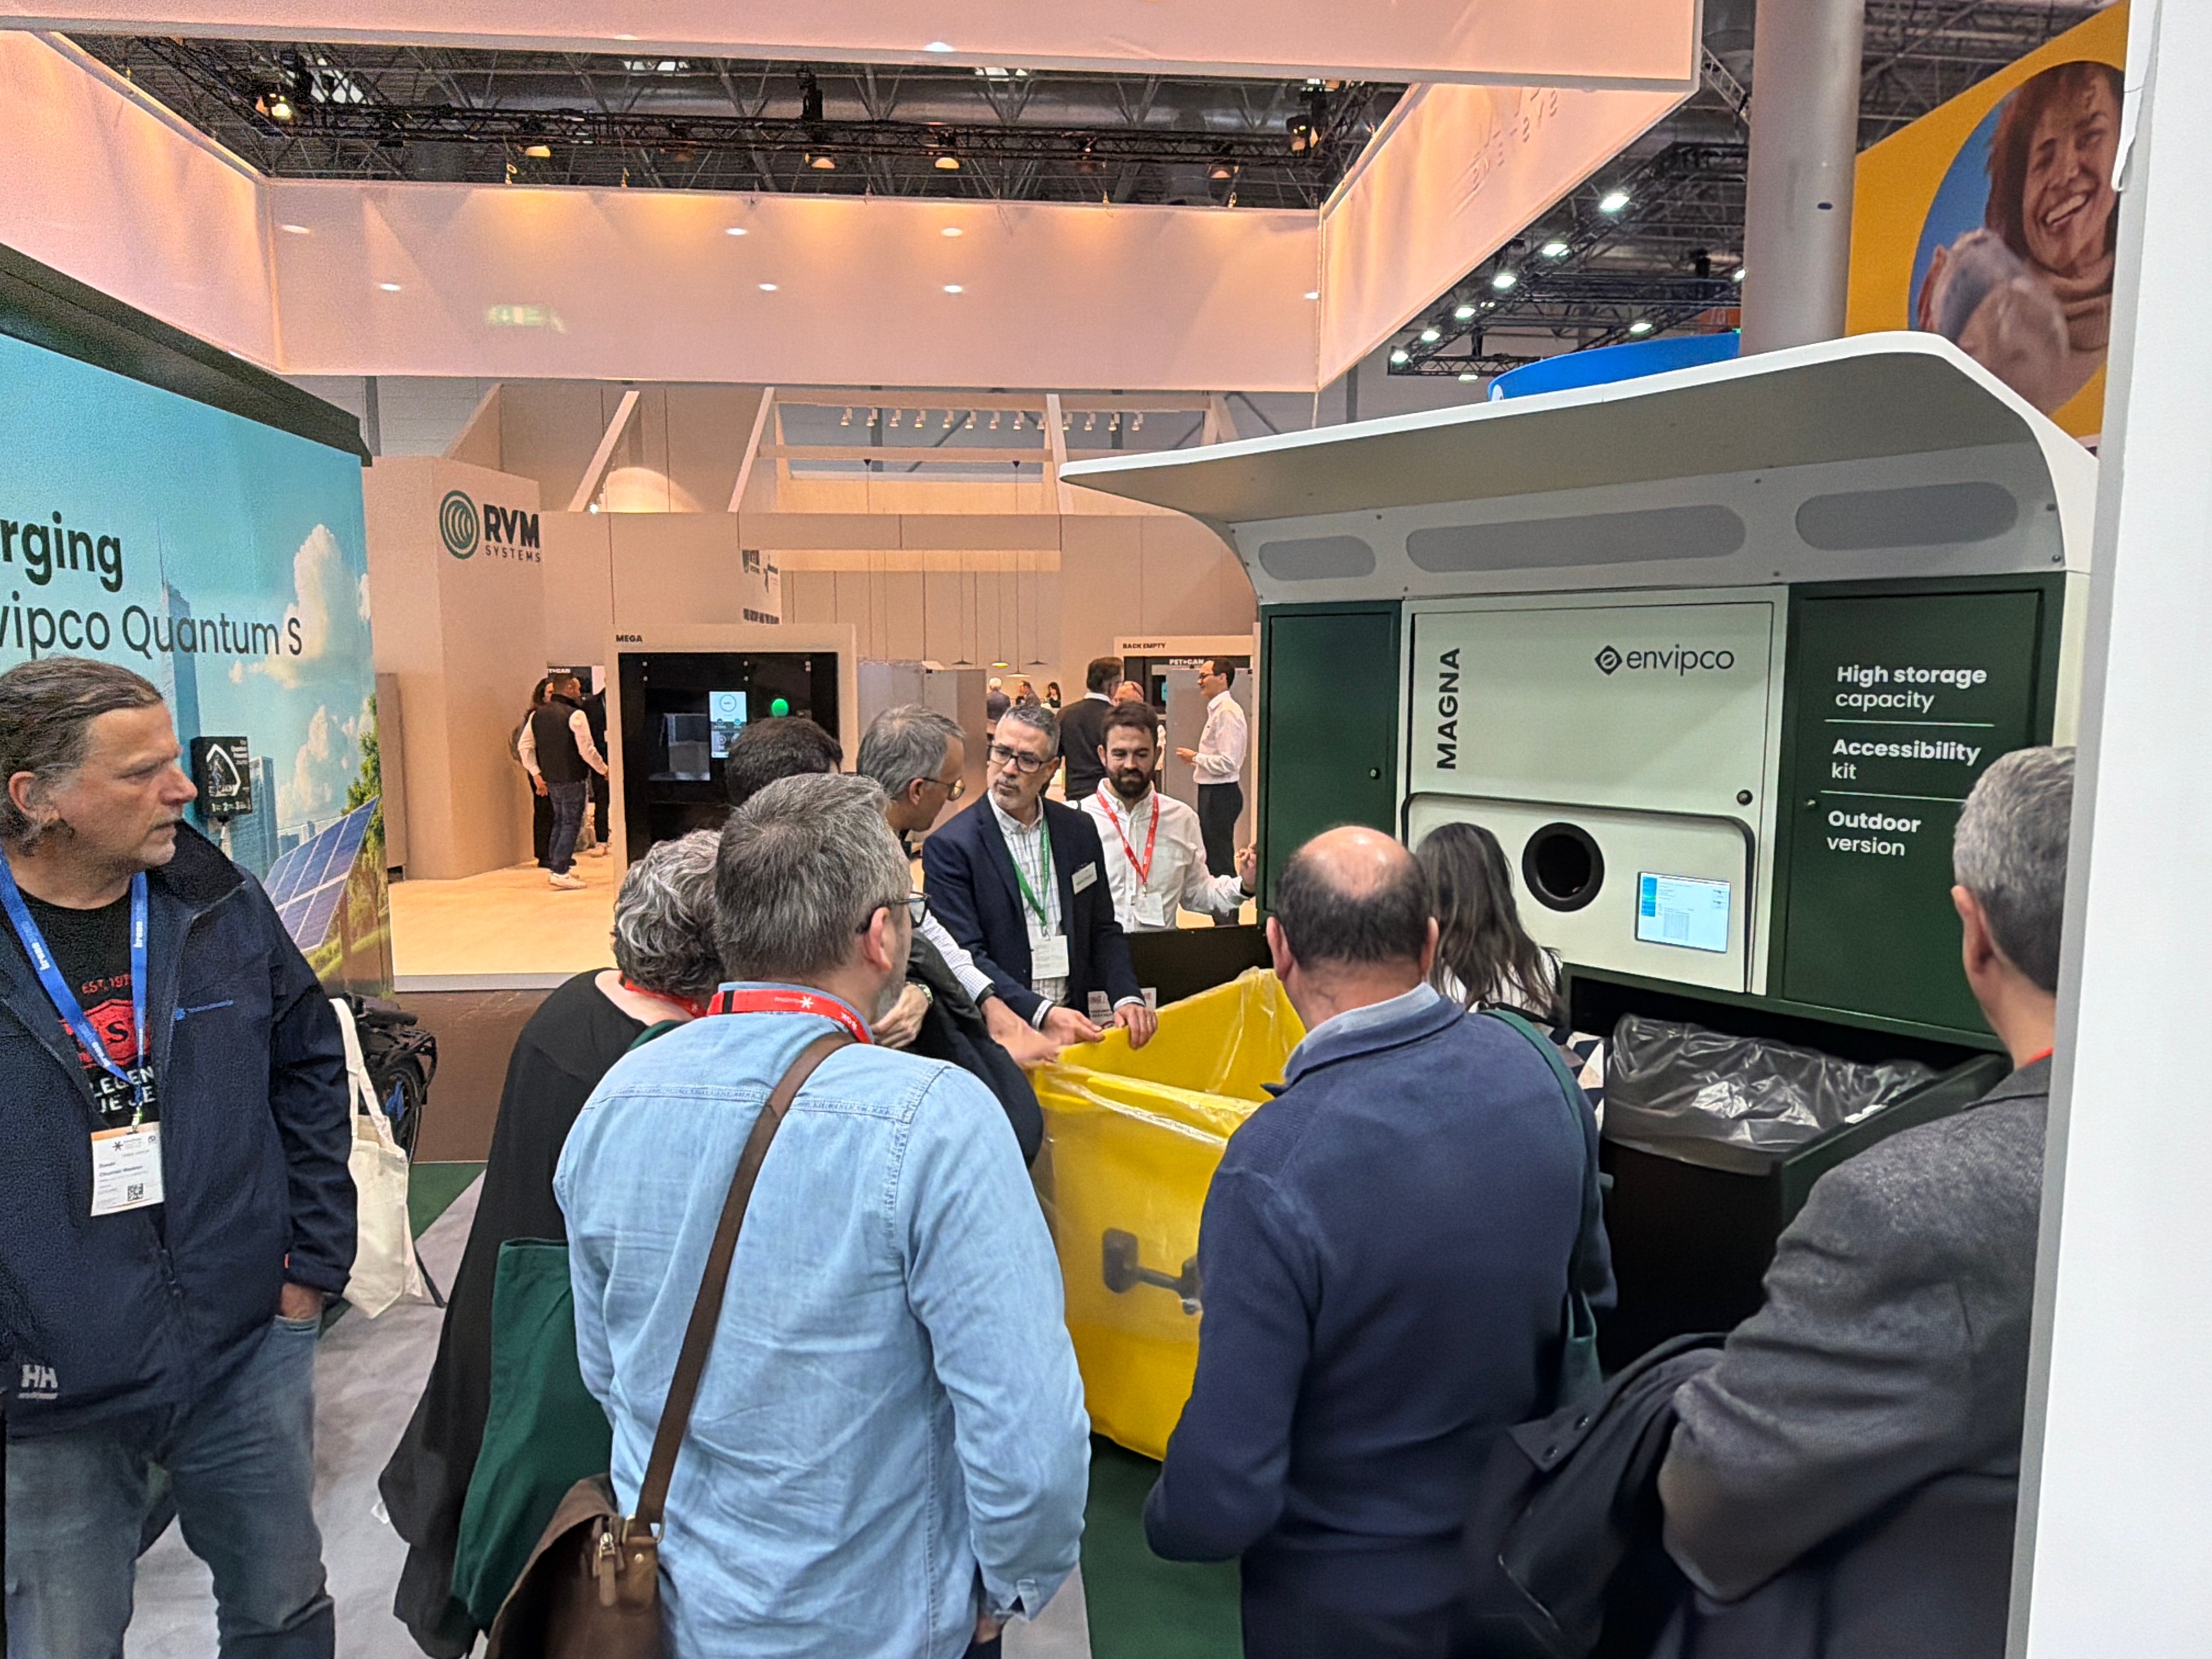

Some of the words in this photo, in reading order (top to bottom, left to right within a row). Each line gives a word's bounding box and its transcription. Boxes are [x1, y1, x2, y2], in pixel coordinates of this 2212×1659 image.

[483, 504, 540, 549] RVM
[0, 511, 123, 592] rging
[485, 545, 541, 563] SYSTEMS
[122, 605, 279, 659] Quantum
[287, 617, 302, 656] S
[616, 634, 643, 642] MEGA
[1627, 644, 1735, 676] envipco
[1837, 664, 1888, 687] High
[1893, 667, 1987, 689] storage
[1436, 648, 1460, 770] MAGNA
[1835, 690, 1935, 713] capacity
[1832, 738, 1982, 766] Accessibility
[1831, 761, 1857, 780] kit
[1828, 810, 1921, 832] Outdoor
[1826, 837, 1905, 856] version
[21, 1364, 58, 1389] HH
